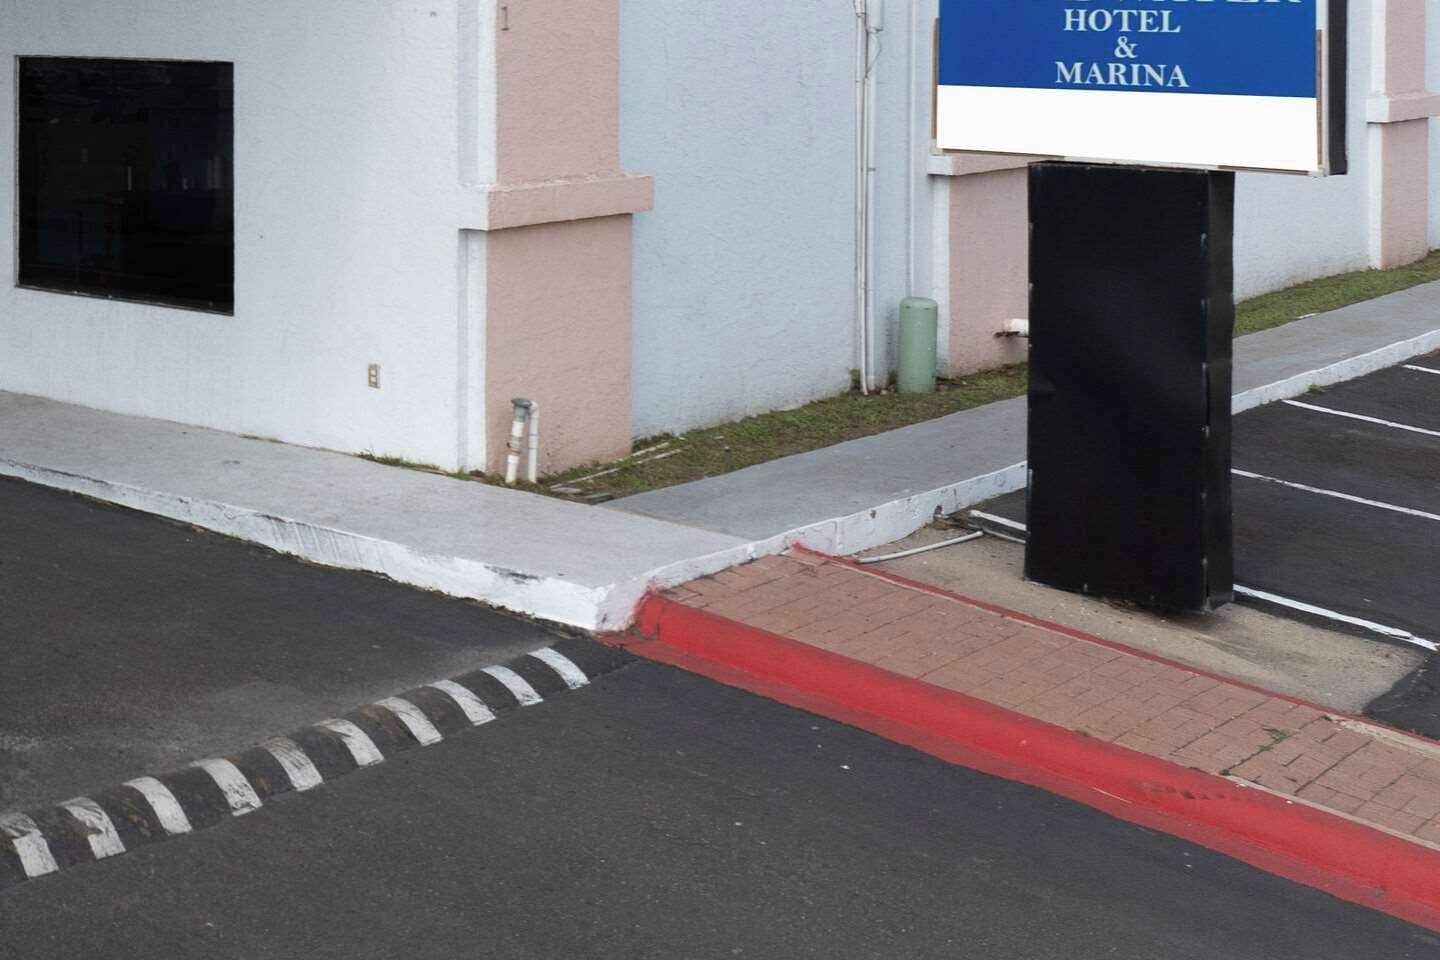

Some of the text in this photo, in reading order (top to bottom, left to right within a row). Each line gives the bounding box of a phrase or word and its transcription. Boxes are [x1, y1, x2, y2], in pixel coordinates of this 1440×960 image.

[1063, 8, 1181, 33] HOTEL
[1114, 36, 1137, 59] &
[1055, 61, 1189, 88] MARINA
